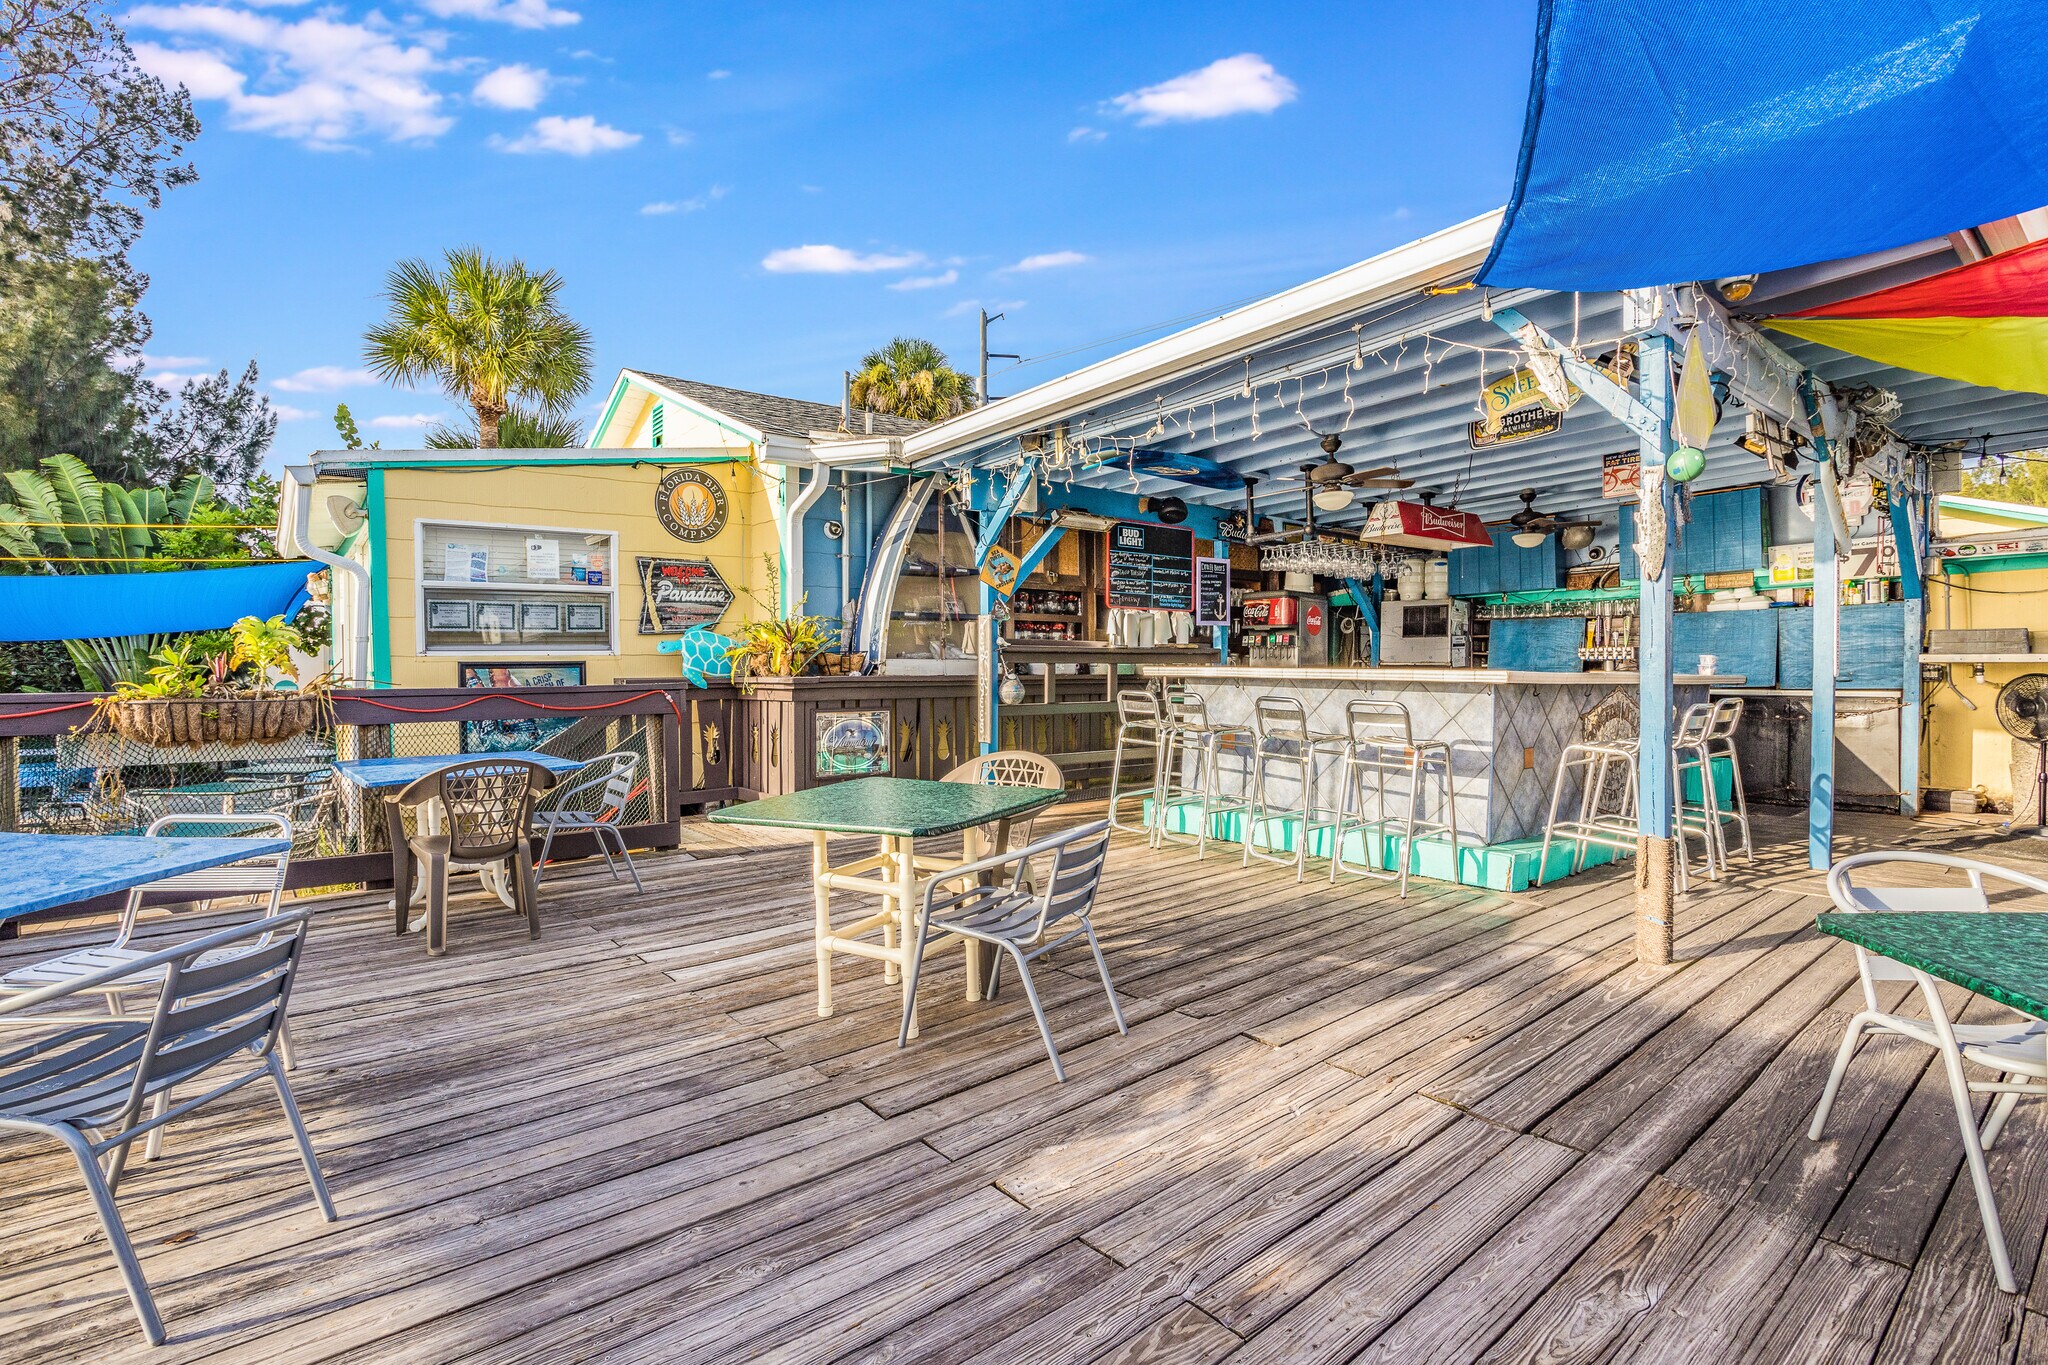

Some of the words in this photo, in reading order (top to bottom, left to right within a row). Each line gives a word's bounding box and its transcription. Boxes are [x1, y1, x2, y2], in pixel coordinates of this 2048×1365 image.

[1501, 408, 1557, 427] BROTHERS
[1606, 459, 1620, 467] FAT
[659, 472, 701, 501] FLORIDA
[704, 478, 724, 506] BEER
[663, 514, 721, 538] COMPANY
[1421, 511, 1464, 529] Budweiser
[1122, 528, 1139, 538] BUD
[1119, 536, 1143, 546] LIGHT
[661, 565, 706, 577] WELCOME
[677, 576, 690, 585] TO
[995, 577, 1015, 589] CROSSING
[656, 580, 725, 604] Paradise
[532, 673, 552, 686] CRISP
